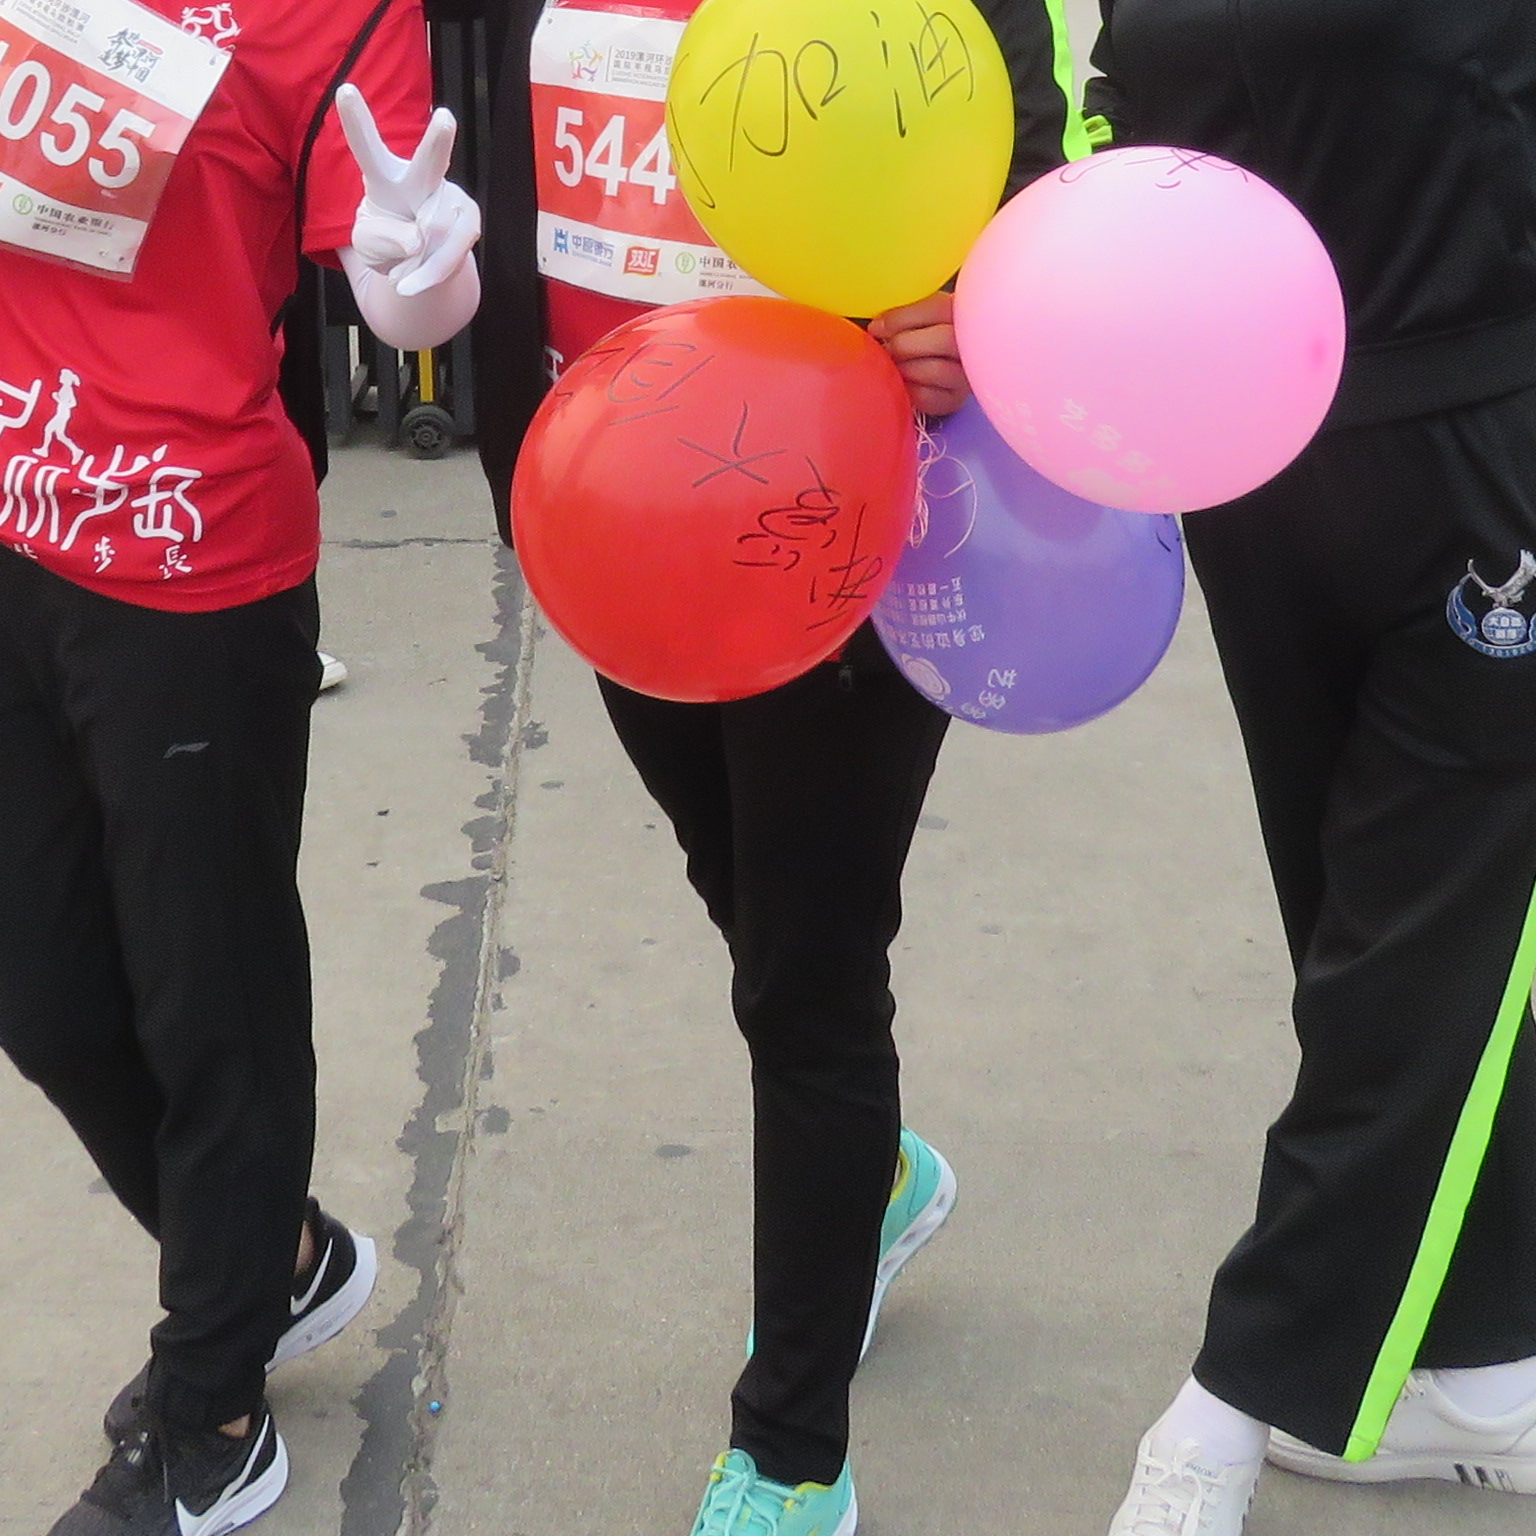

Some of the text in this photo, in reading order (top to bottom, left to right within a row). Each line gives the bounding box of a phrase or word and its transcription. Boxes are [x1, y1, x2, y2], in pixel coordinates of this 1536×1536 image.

[700, 1, 978, 172] 加油
[554, 106, 678, 206] 544
[627, 247, 657, 269] 双汇
